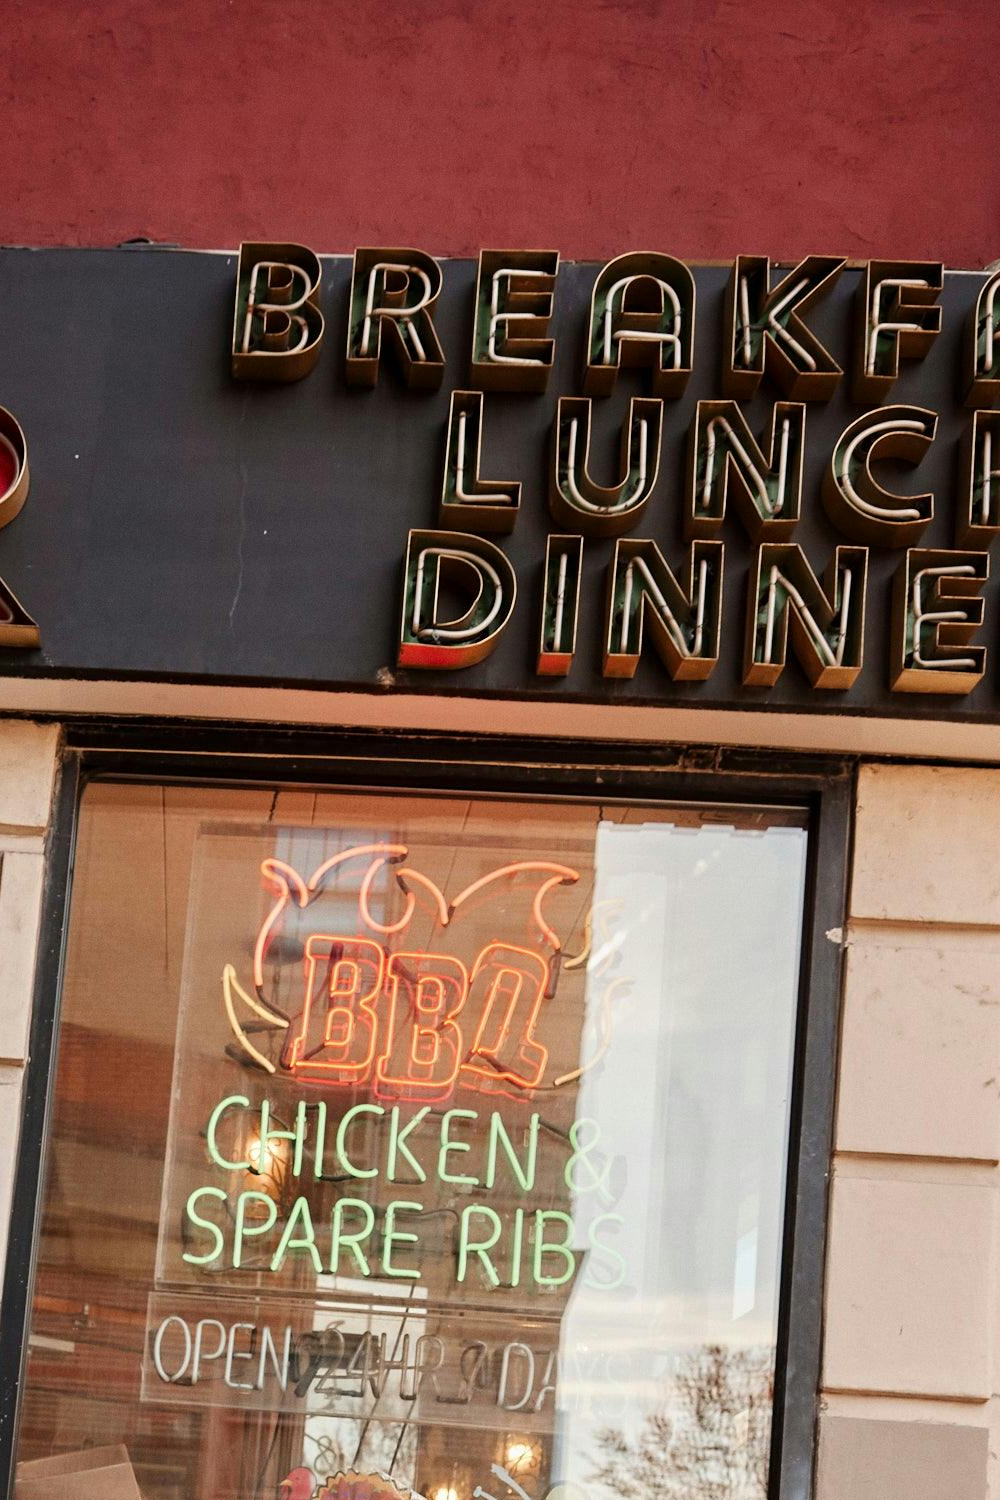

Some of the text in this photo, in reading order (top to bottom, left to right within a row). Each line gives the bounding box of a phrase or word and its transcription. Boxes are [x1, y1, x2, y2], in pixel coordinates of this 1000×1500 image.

[398, 528, 990, 695] DINNE
[289, 934, 549, 1088] BBQ
[206, 1095, 616, 1200] CHICKEN &
[182, 1186, 628, 1290] SPARE RIBS
[154, 1316, 292, 1392] OPEN
